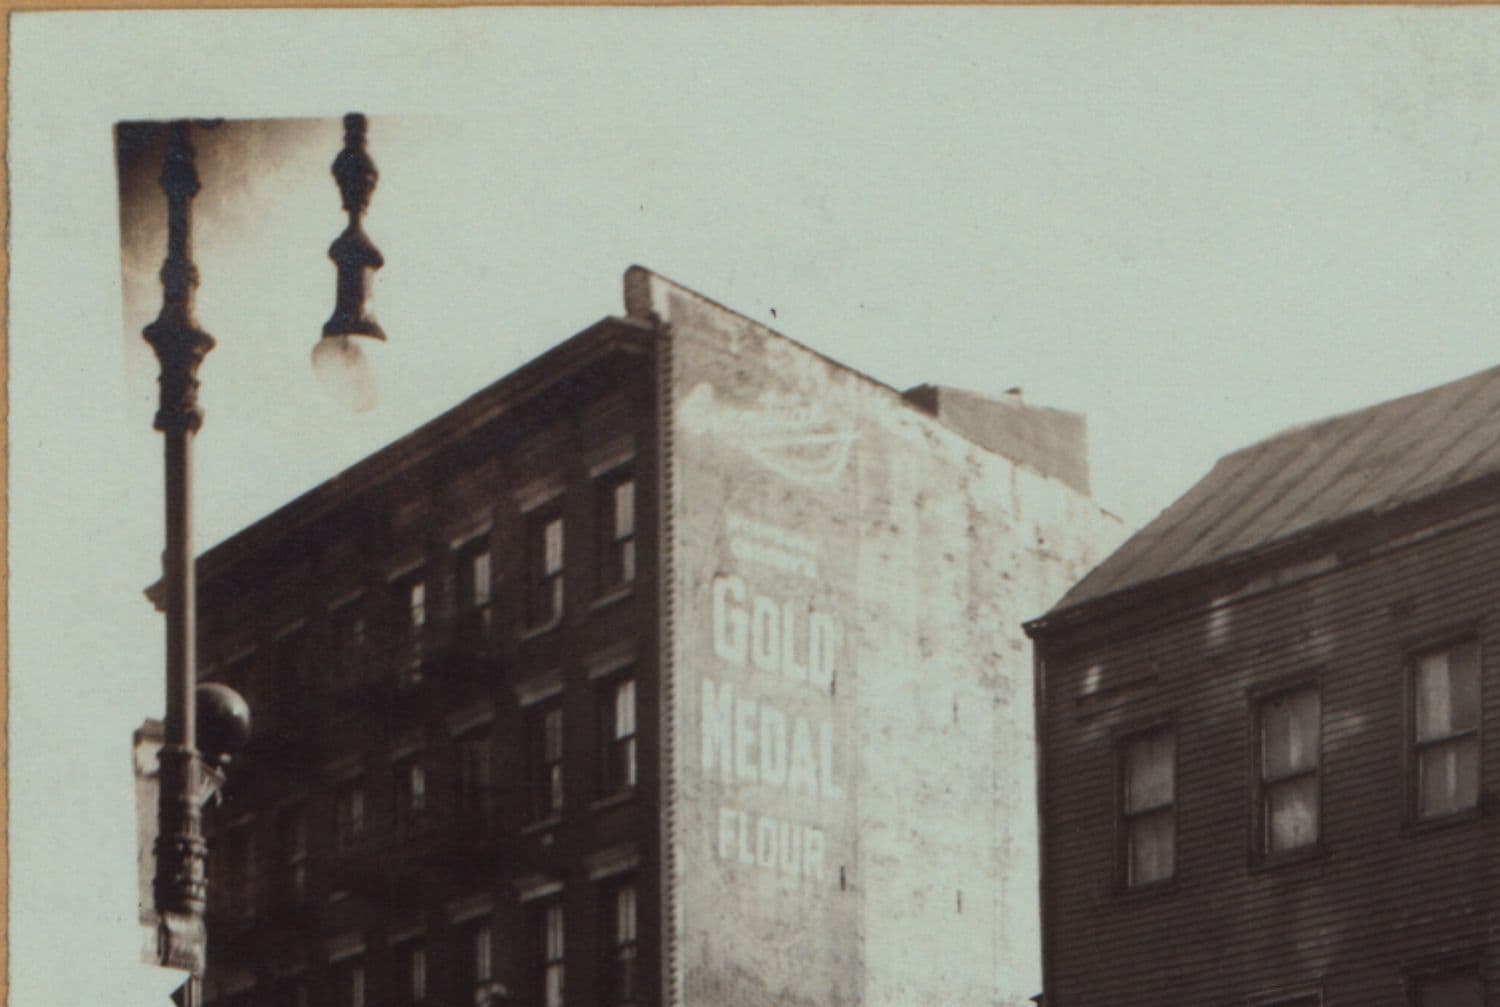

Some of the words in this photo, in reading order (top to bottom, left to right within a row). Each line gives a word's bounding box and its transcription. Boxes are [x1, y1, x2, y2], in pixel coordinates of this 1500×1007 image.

[713, 575, 835, 691] GOLD
[702, 677, 843, 800] MEDAL
[718, 806, 824, 881] FLOUR
